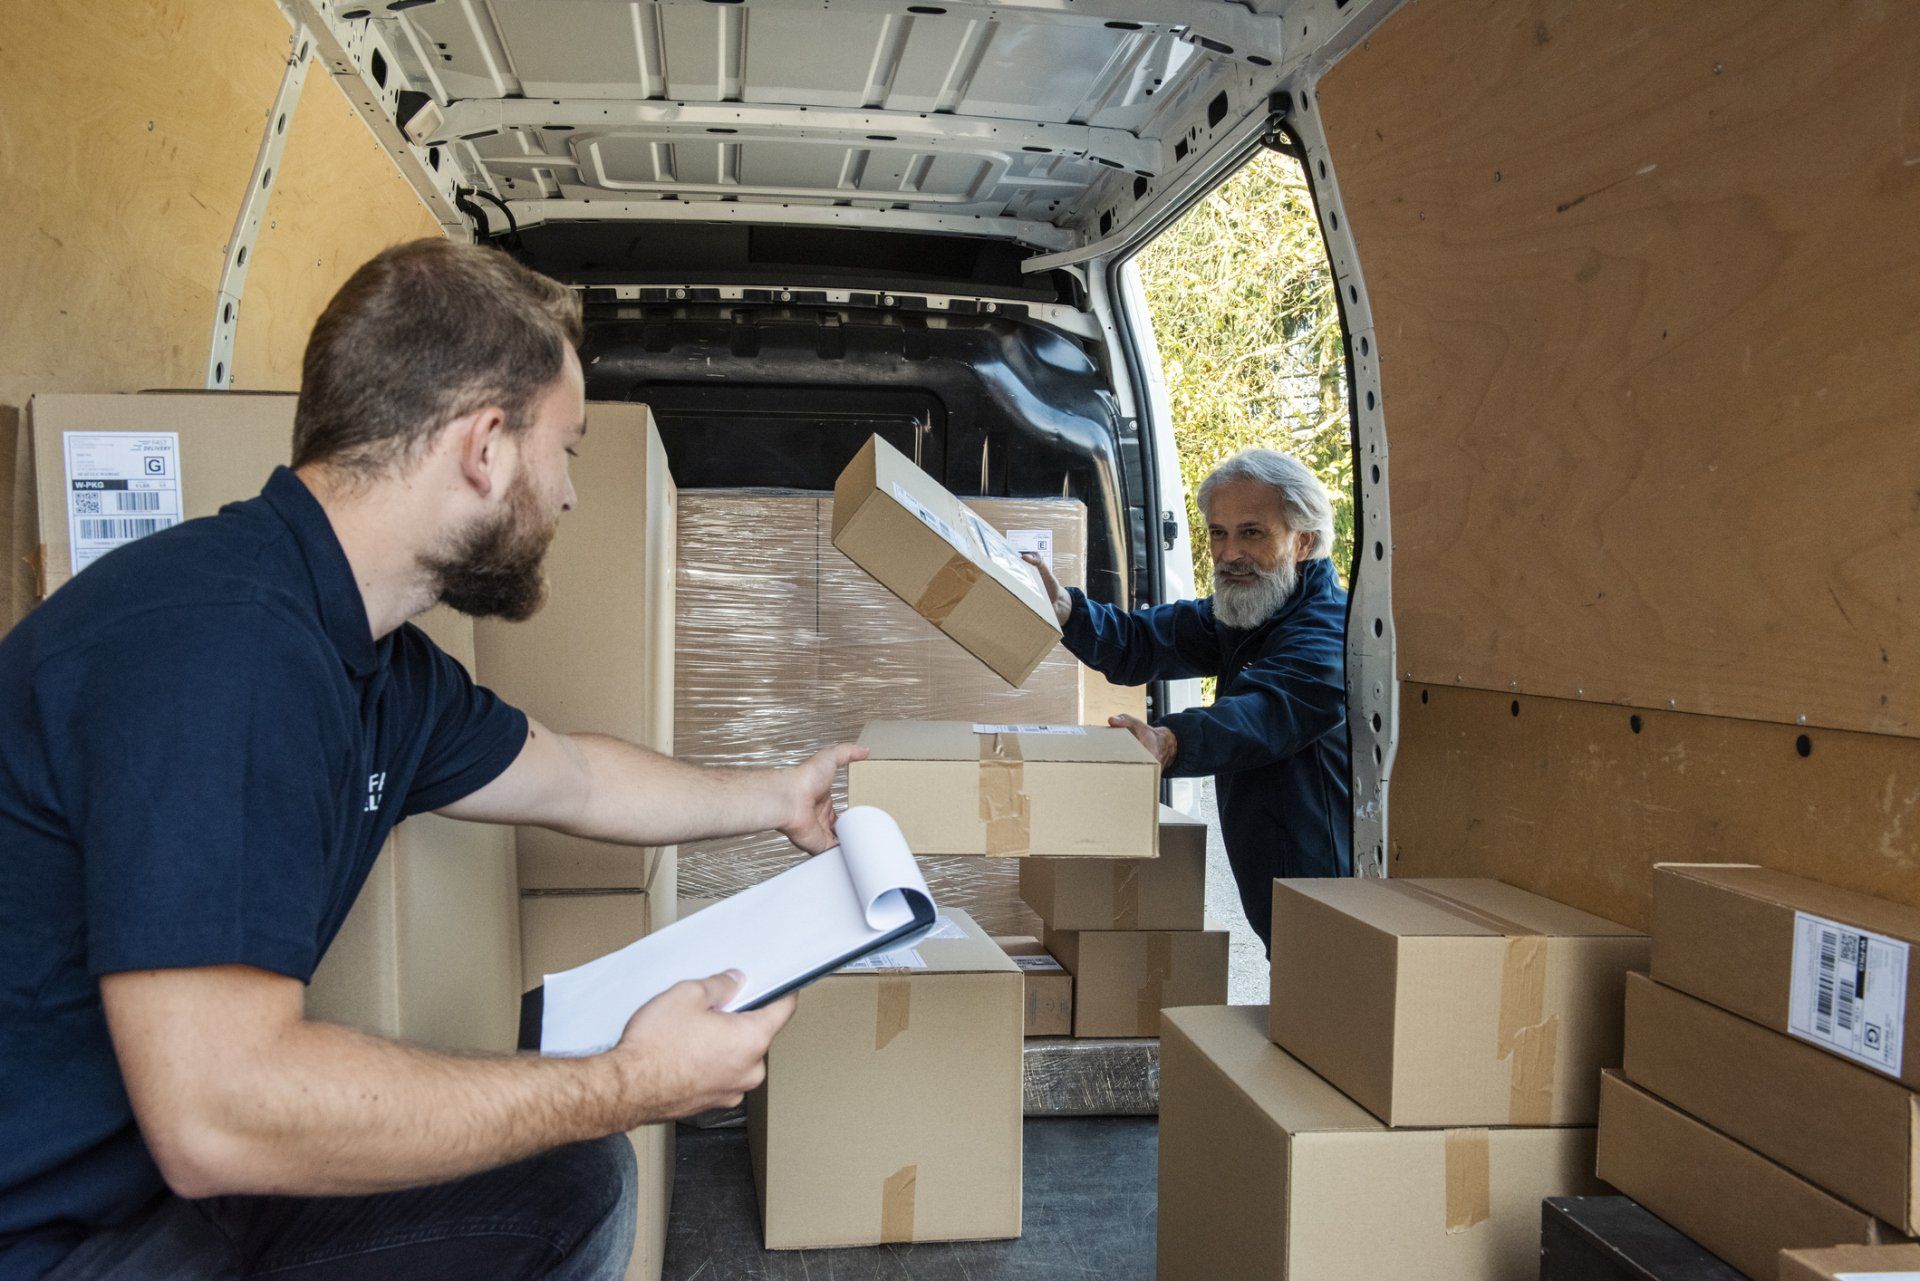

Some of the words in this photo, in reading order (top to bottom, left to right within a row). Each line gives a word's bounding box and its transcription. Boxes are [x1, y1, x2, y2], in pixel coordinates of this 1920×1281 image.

[148, 459, 161, 472] G
[75, 481, 104, 489] W-PKG
[1859, 939, 1867, 972] W-PKG
[1867, 1028, 1880, 1044] G
